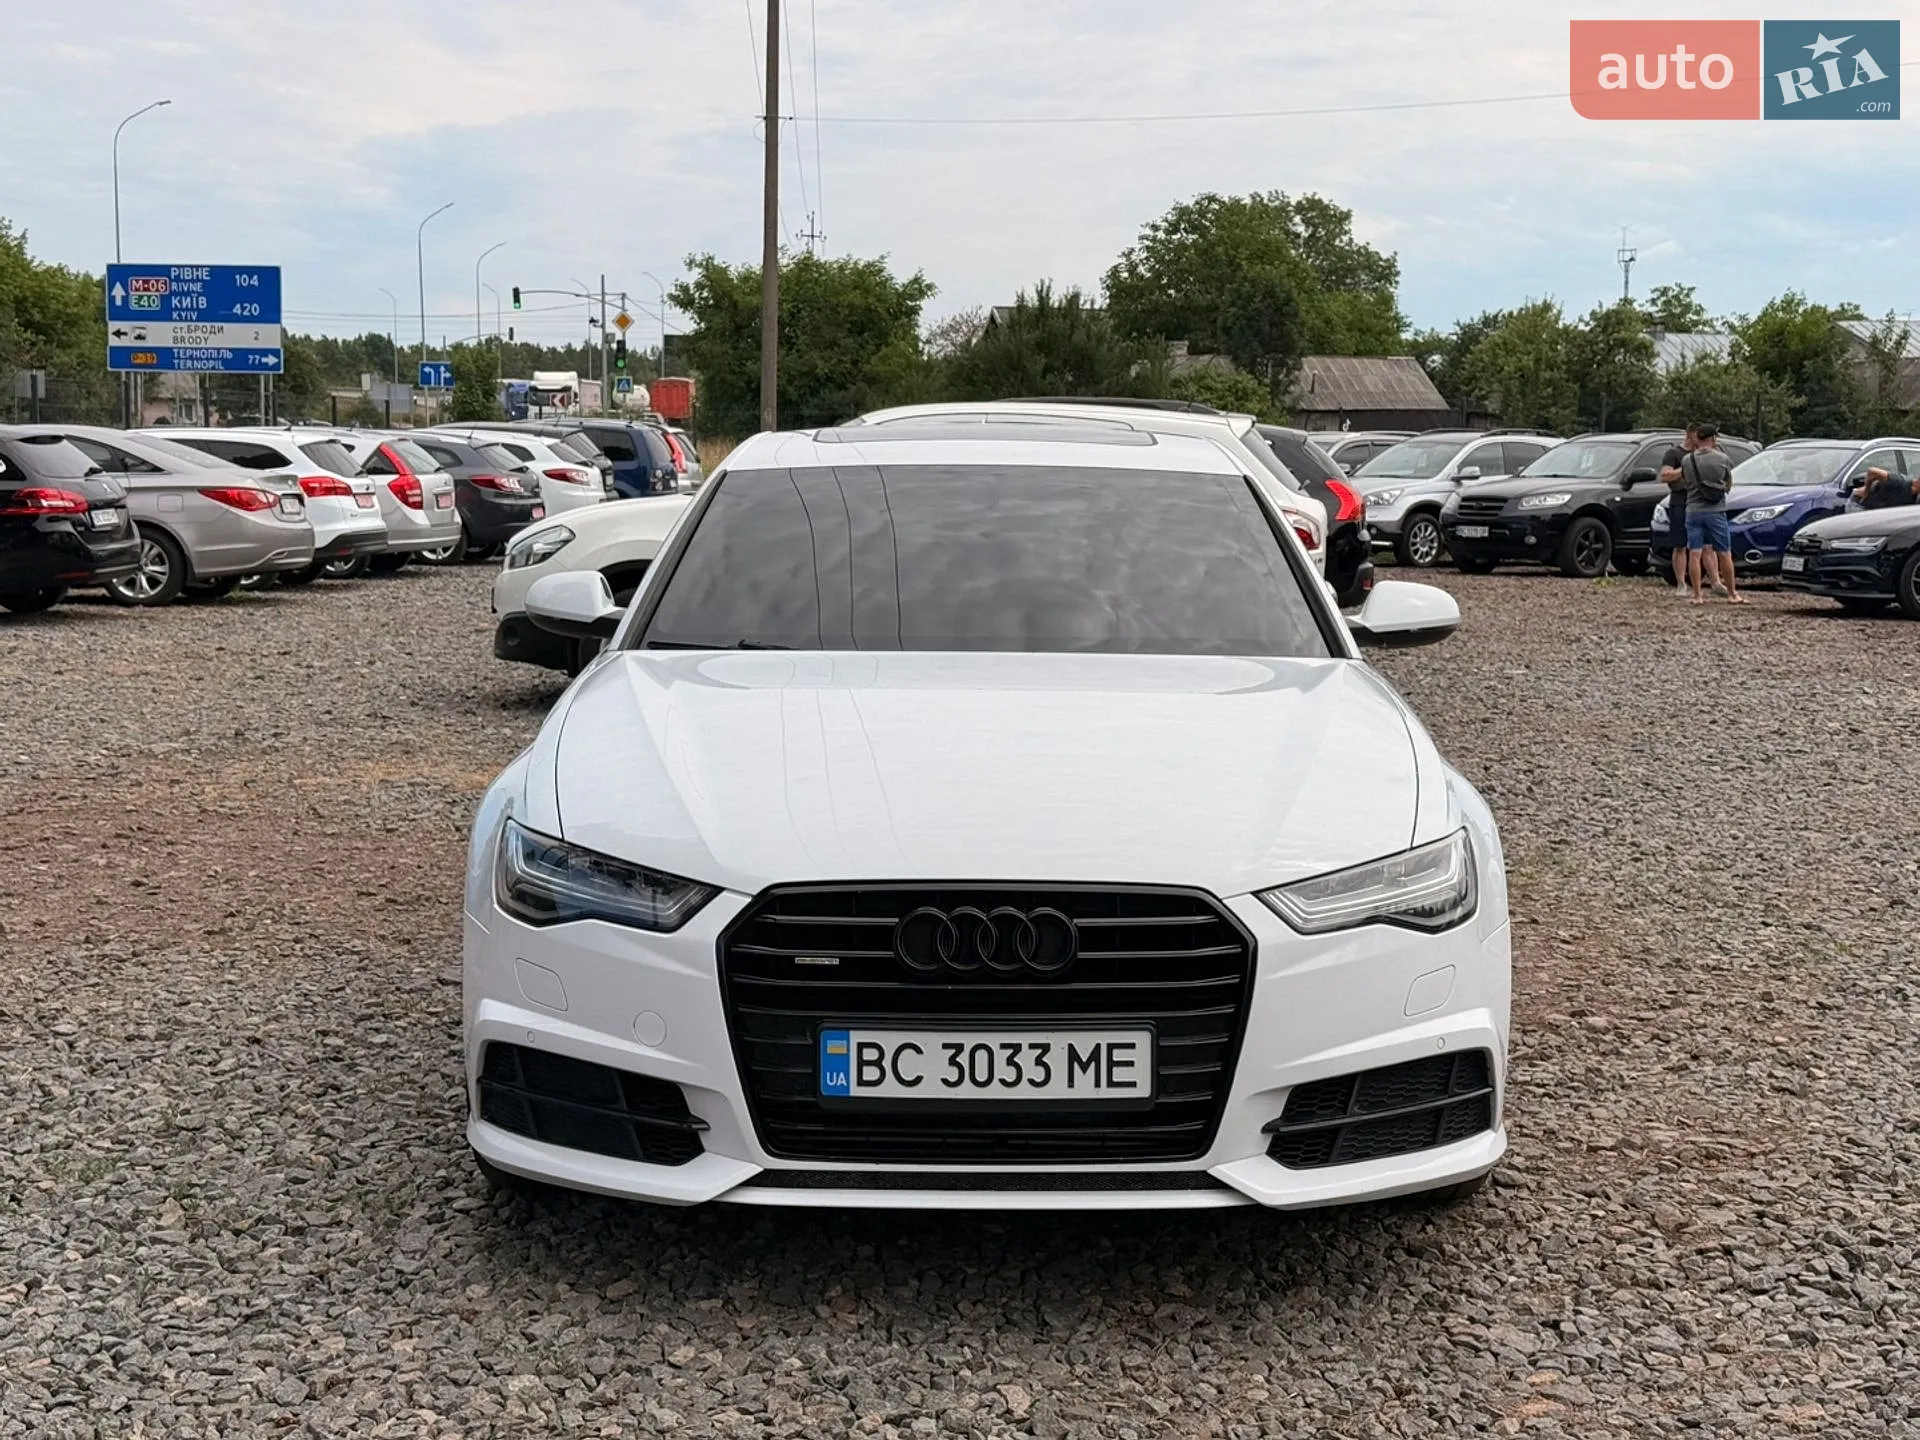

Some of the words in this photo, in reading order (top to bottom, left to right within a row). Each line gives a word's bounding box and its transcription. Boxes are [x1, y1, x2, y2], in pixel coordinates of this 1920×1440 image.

[170, 267, 211, 280] РІВНЕ
[235, 274, 259, 288] 104
[171, 282, 204, 292] RIVNE
[131, 295, 158, 308] E40
[172, 294, 207, 309] КИЇВ
[232, 303, 260, 316] 420
[172, 311, 198, 321] KYIV
[172, 336, 209, 345] BRODY
[254, 331, 260, 341] 2
[172, 349, 233, 359] ТЕРНОПІЛЬ
[172, 360, 224, 370] TERNOPIL
[248, 355, 260, 365] 77
[856, 1042, 924, 1088] BC
[940, 1042, 1052, 1088] 3033
[1067, 1042, 1138, 1088] ME
[826, 1072, 847, 1087] UA
